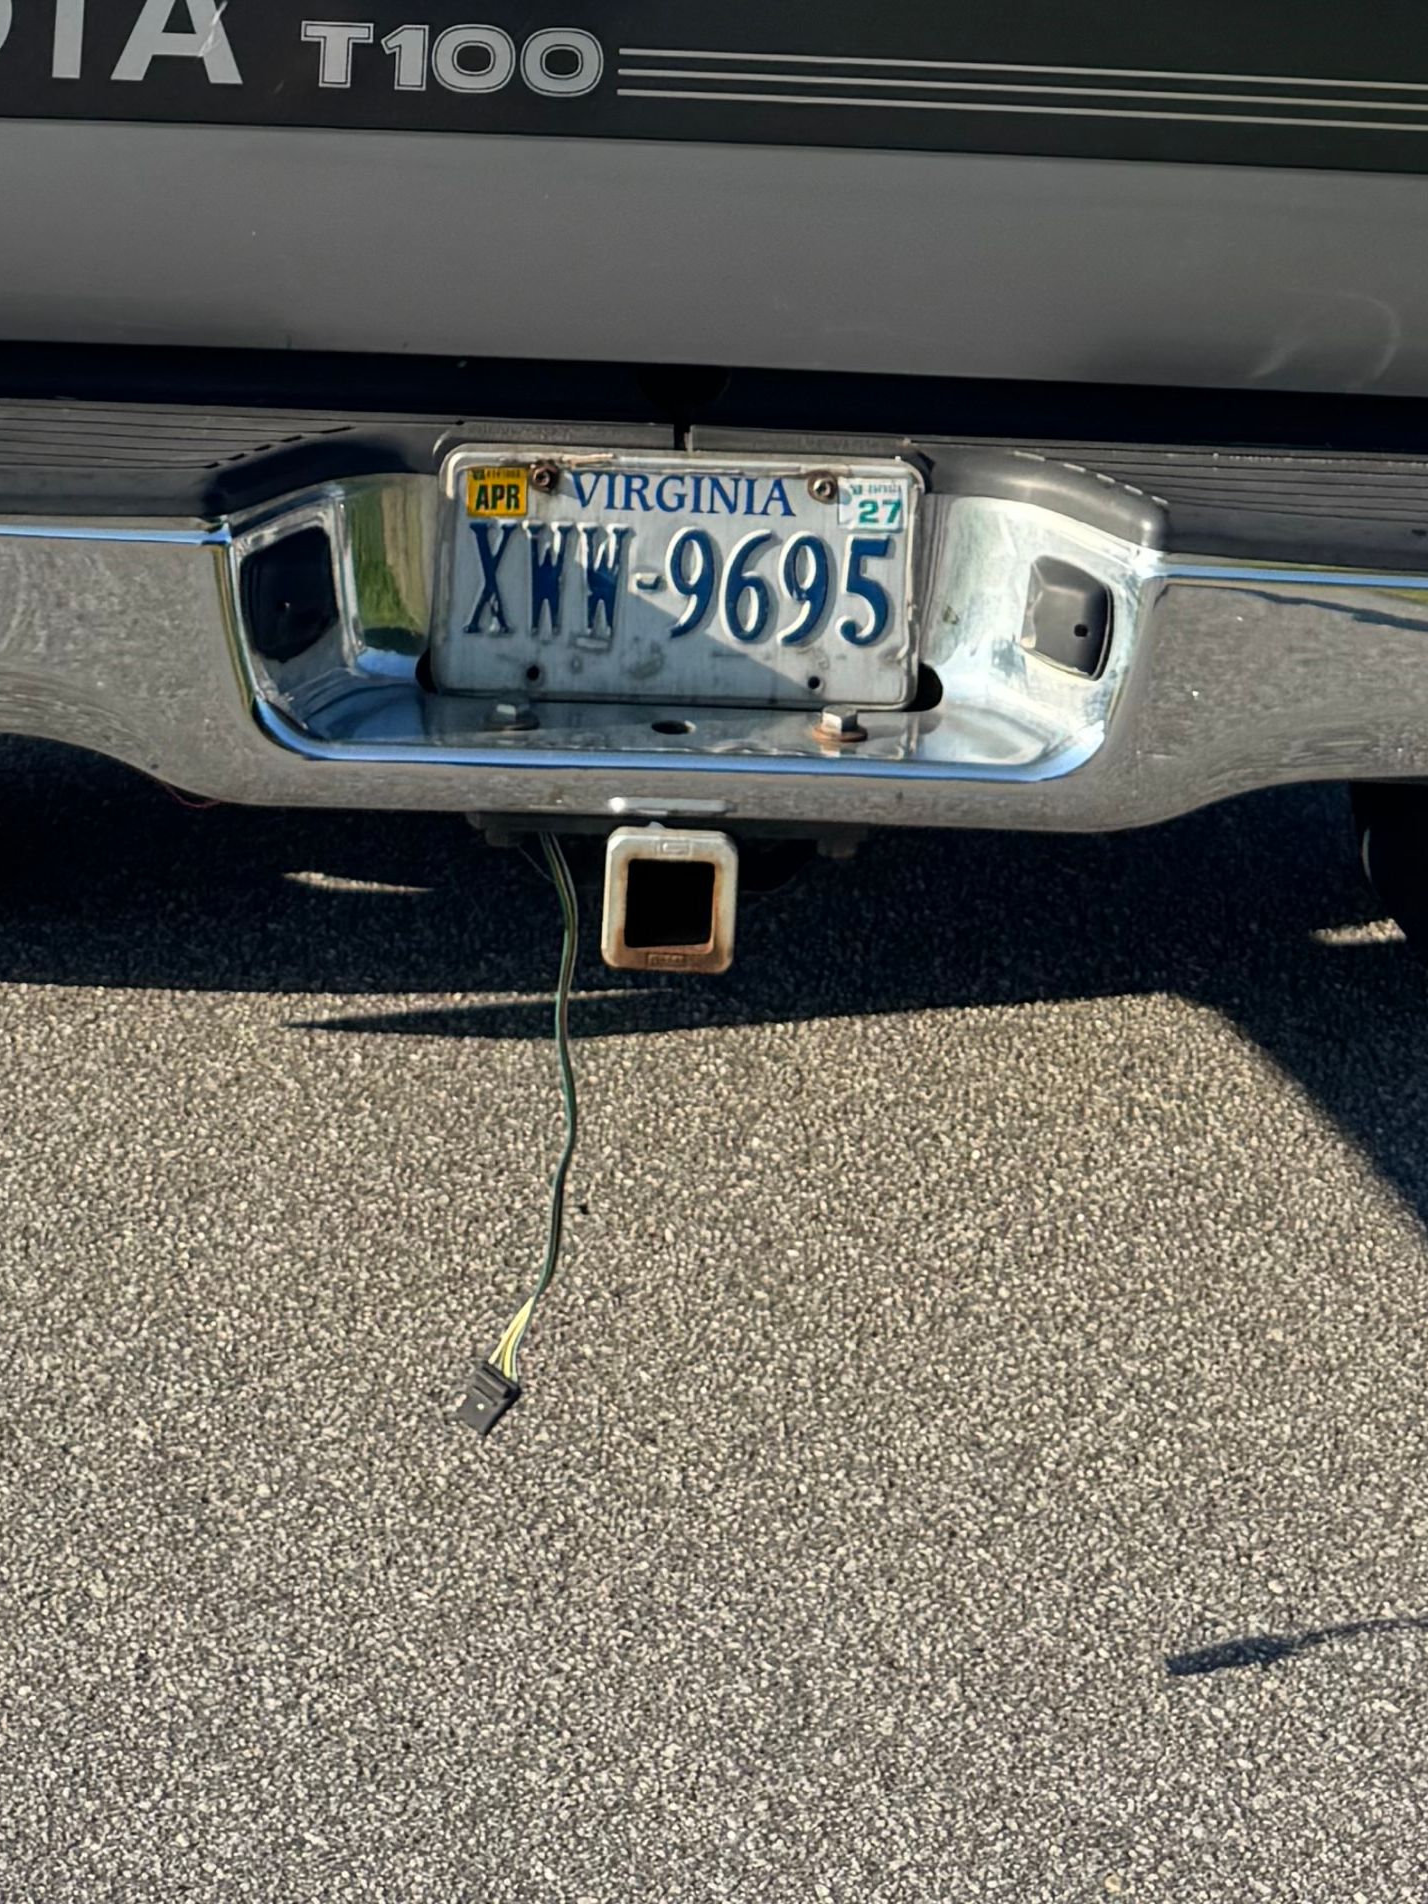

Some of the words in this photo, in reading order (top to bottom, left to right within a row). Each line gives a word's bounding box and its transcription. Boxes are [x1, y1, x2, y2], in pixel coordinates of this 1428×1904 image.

[300, 20, 604, 98] T100
[475, 484, 520, 511] APR
[571, 471, 796, 517] VIRGINIA
[858, 499, 902, 524] 27
[463, 520, 891, 647] XWW-9695
